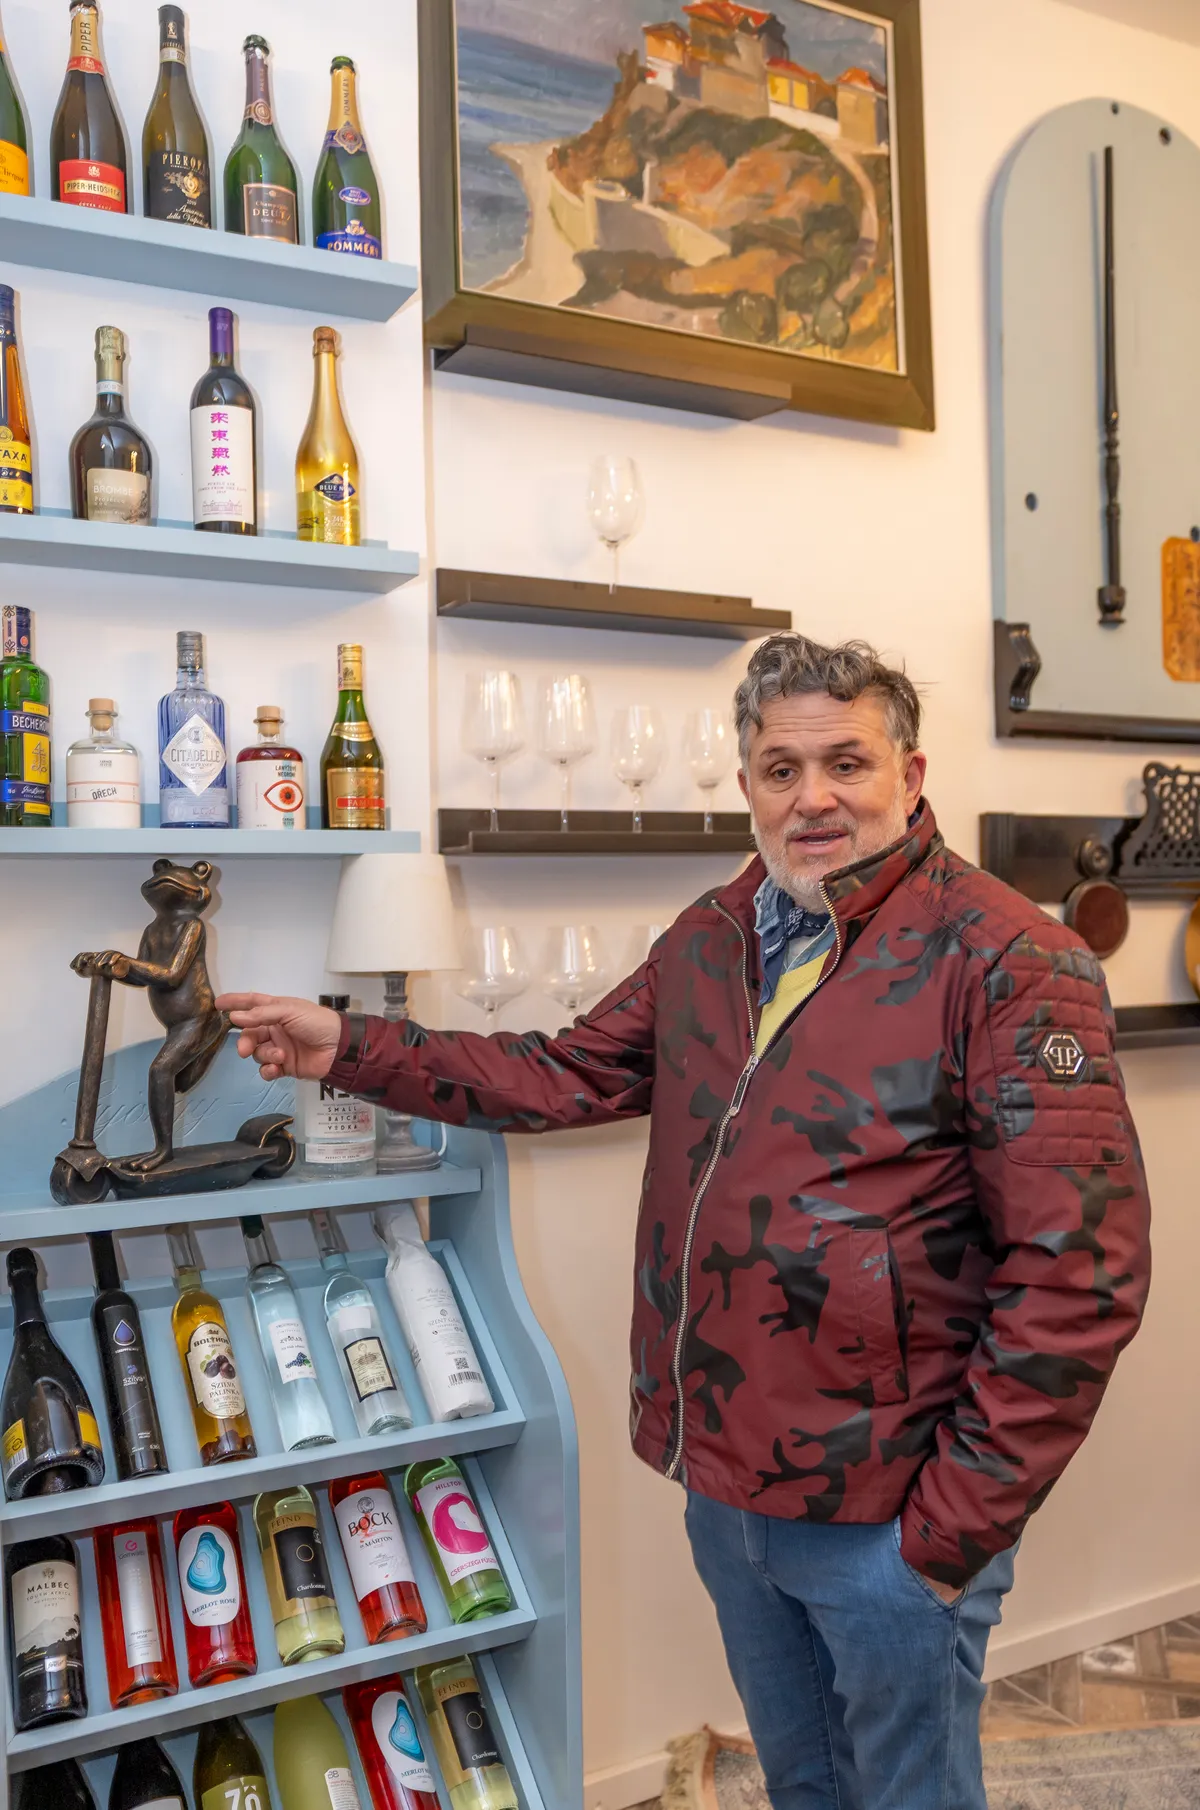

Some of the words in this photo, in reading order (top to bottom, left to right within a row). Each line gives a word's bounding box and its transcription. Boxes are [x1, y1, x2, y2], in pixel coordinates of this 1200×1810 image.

[80, 21, 92, 52] PIPER
[66, 182, 121, 197] PIPER-HEIDSIECK
[327, 239, 379, 258] POMMERY
[0, 449, 27, 464] AXA
[170, 748, 221, 763] CITADELLE
[328, 1114, 357, 1122] BATCH
[271, 1514, 301, 1529] FEIND
[348, 1512, 393, 1538] BOCK
[450, 1558, 481, 1577] CSERSZEGI
[27, 1581, 70, 1595] MALBEC
[296, 1582, 326, 1592] Chardonnay
[26, 1591, 48, 1601] SOUTH
[191, 1600, 219, 1615] MERLOT
[400, 1768, 425, 1778] MERLOT
